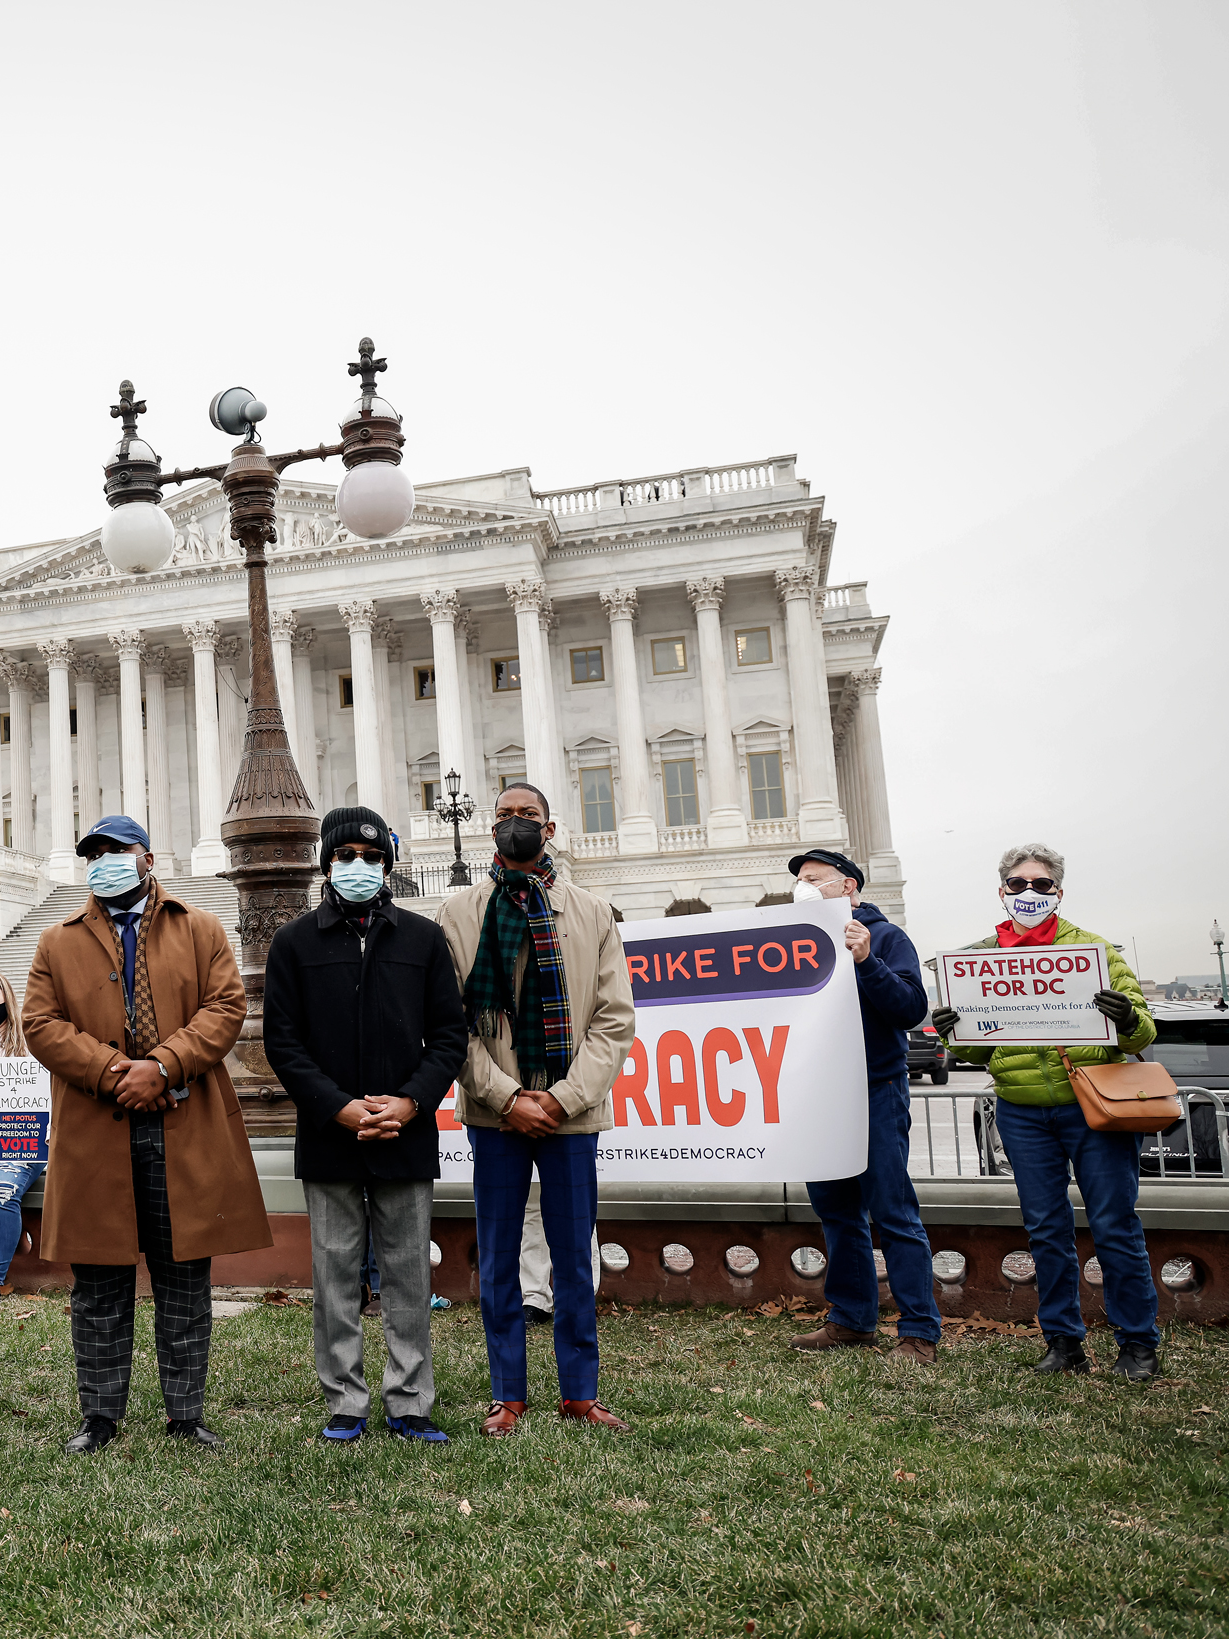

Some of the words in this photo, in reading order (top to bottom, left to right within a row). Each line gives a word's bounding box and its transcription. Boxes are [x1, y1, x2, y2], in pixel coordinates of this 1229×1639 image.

[1015, 901, 1035, 911] VOTE
[1036, 900, 1049, 908] 411
[626, 948, 719, 984] RIKE
[732, 939, 819, 976] FOR
[953, 956, 1091, 978] STATEHOOD
[981, 980, 1028, 997] FOR
[1033, 978, 1066, 995] DC
[956, 1005, 990, 1014] Making
[991, 1003, 1041, 1013] Democracy
[1042, 1002, 1068, 1011] Work
[1069, 1001, 1083, 1010] for
[977, 1021, 999, 1031] LWV
[612, 1025, 790, 1127] RACY
[0, 1138, 38, 1151] VOTE
[596, 1147, 766, 1160] RSTRIKE4DEMOCRACY
